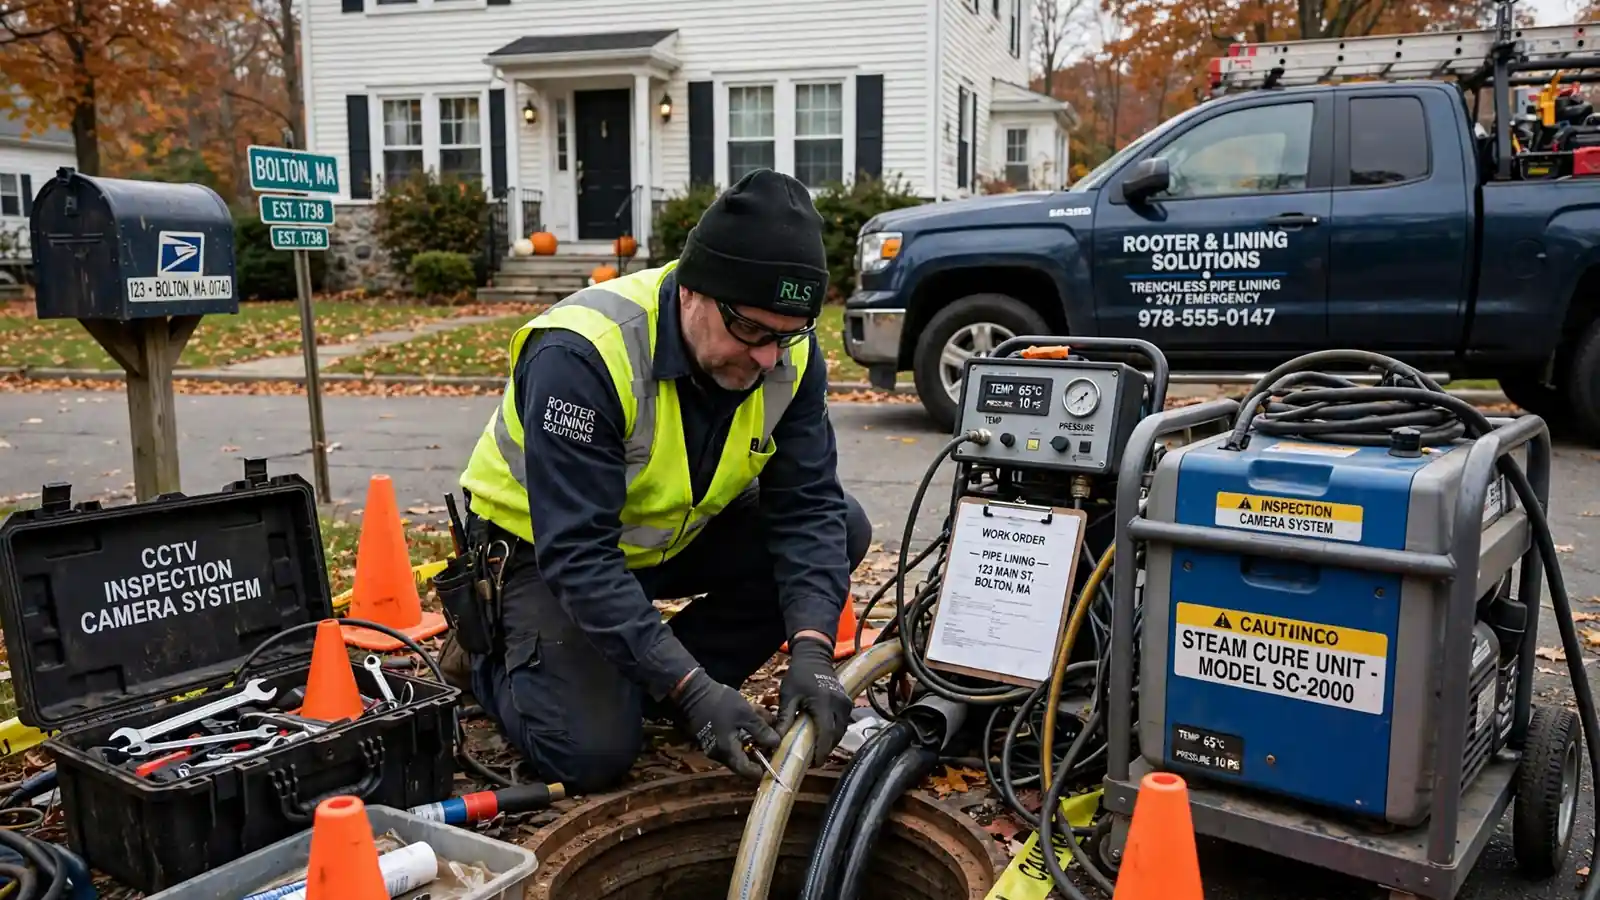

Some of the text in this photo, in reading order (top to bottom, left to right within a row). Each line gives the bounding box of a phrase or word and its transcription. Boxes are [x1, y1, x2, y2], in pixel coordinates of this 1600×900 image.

[255, 155, 336, 188] BOLTON, MA
[272, 200, 325, 220] EST. 1738
[277, 230, 323, 245] EST. 1738
[1123, 231, 1289, 252] ROOTER & LINING
[1151, 251, 1261, 271] SOLUTIONS
[130, 281, 146, 298] 123
[155, 279, 192, 298] BOLTON,
[193, 279, 207, 296] MA
[780, 281, 812, 301] RLS
[1130, 279, 1281, 293] TRENCHLESS PIPE LINING
[1156, 292, 1260, 306] 24/7 EMERGENCY
[1138, 308, 1276, 328] 978-555-0147
[991, 383, 1042, 396] TEMP 65°C
[547, 396, 596, 422] ROOTER
[1020, 397, 1031, 408] 10
[544, 408, 594, 433] & LINING
[1059, 422, 1095, 432] PRESSURE
[543, 421, 592, 443] SOLUTIONS
[1260, 499, 1332, 519] INSPECTION
[1240, 512, 1333, 534] CAMERA SYSTEM
[982, 528, 1046, 546] WORK ORDER
[141, 540, 197, 569] CCTV
[982, 550, 1036, 567] PIPE LINING
[104, 559, 233, 603] INSPECTION
[978, 564, 1035, 582] 123 MAIN ST,
[974, 577, 1031, 595] BOLTON, MA
[81, 577, 262, 634] CAMERA SYSTEM
[1182, 629, 1247, 658] STEAM
[1253, 642, 1309, 670] CURE
[1316, 651, 1365, 679] UNIT
[1199, 656, 1354, 704] MODEL SC-2000
[1178, 729, 1200, 741] TEMP
[1215, 756, 1226, 768] 10
